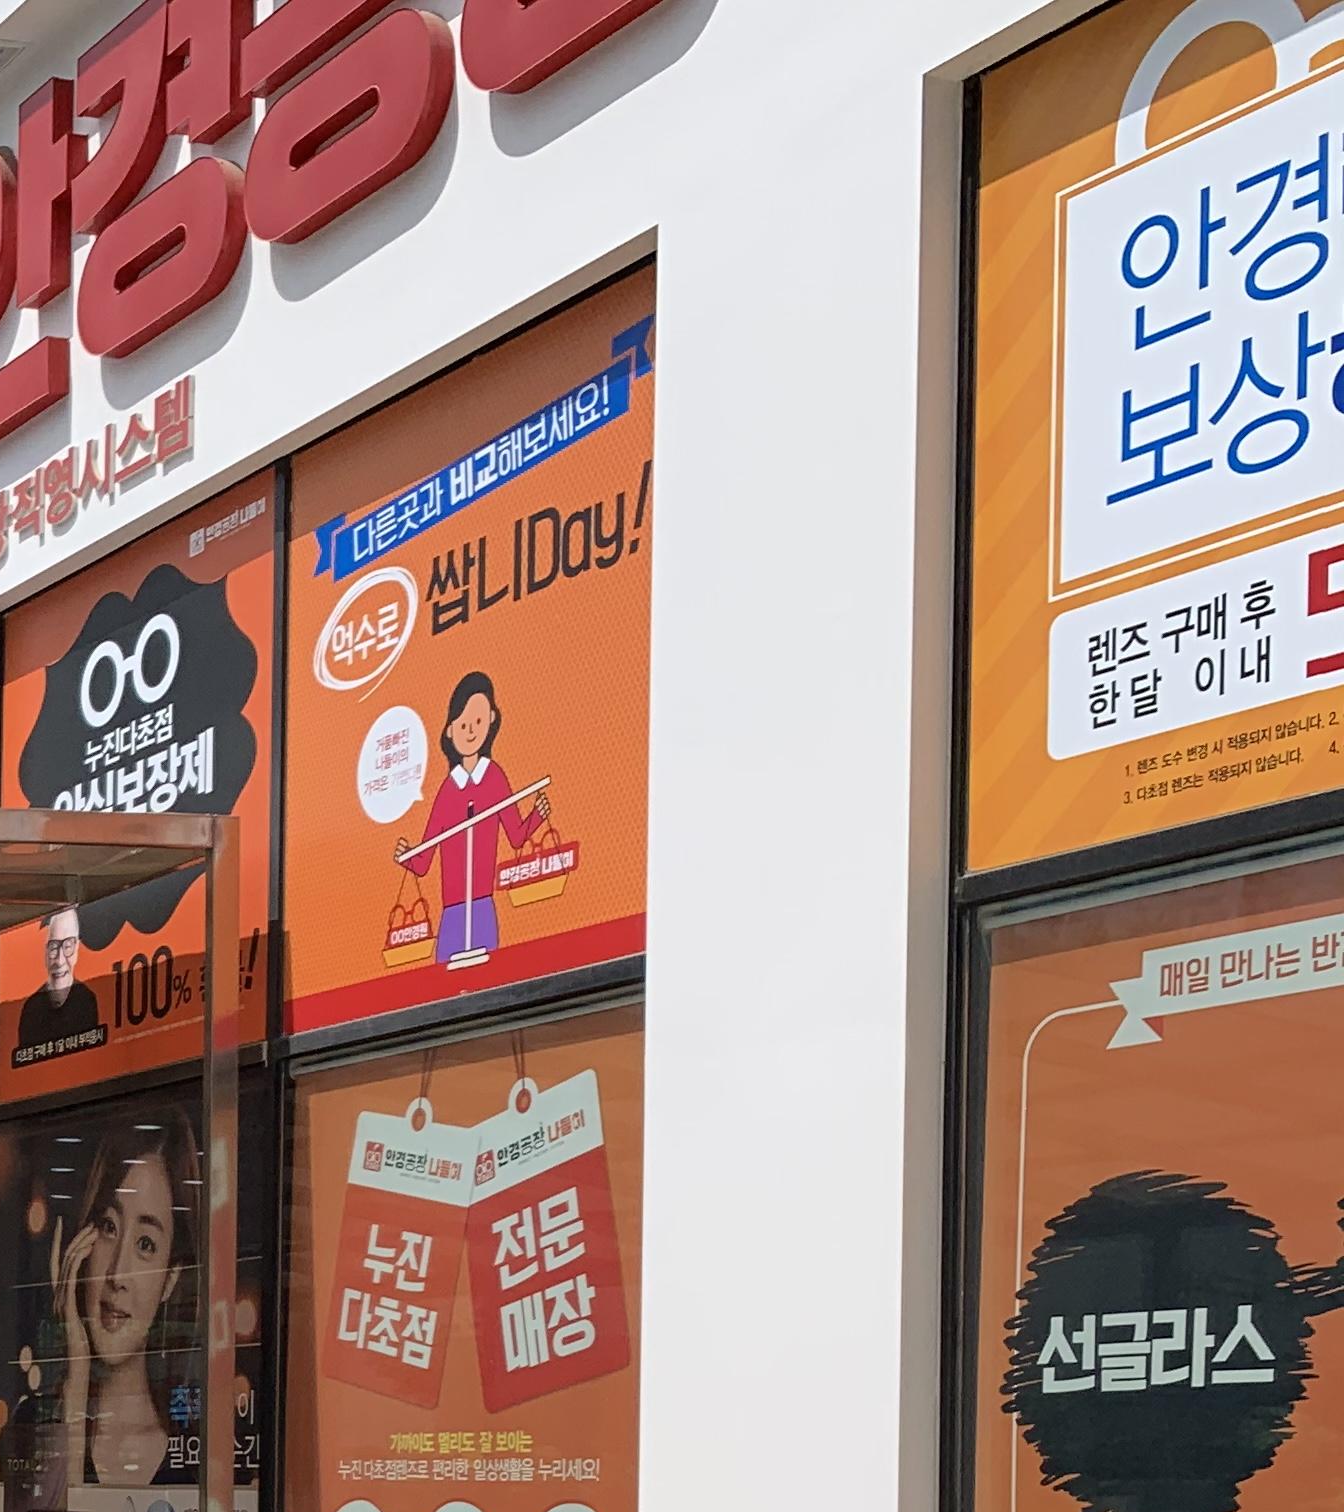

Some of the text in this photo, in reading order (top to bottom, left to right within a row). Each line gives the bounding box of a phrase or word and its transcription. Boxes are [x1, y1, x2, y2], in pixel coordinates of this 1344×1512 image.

[1121, 131, 1344, 351] 안경
[1106, 310, 1344, 506] 보상
[353, 374, 610, 563] 다른곳과 비교해보세요!
[331, 602, 400, 667] 억수로
[1088, 621, 1150, 678] 렌즈
[1161, 591, 1227, 654] 구매
[1240, 579, 1277, 631] 후
[1195, 634, 1272, 696] 이내
[84, 703, 174, 773] 누진다초점
[1137, 758, 1158, 775] 렌즈
[1162, 750, 1183, 767] 도수
[1187, 743, 1208, 762] 변경
[1211, 740, 1223, 756] 시
[1227, 726, 1272, 751] 적용되지
[1275, 713, 1325, 740] 않습니다.
[1136, 781, 1168, 801] 다초점
[1171, 773, 1204, 793] 렌즈는
[1207, 762, 1252, 783] 적용되지
[1255, 747, 1304, 773] 않습니다.
[114, 945, 192, 1029] 100%
[1159, 930, 1344, 998] 매일 만나는 반
[384, 1146, 428, 1174] 안경공장
[496, 1123, 546, 1168] 안경공장
[362, 1222, 433, 1293] 누진
[491, 1186, 586, 1292] 전문
[337, 1286, 439, 1371] 다초점
[499, 1273, 597, 1373] 매장
[1036, 1303, 1276, 1395] 선글라스
[495, 1430, 534, 1453] 보이는
[538, 1457, 601, 1482] 누리세요!
